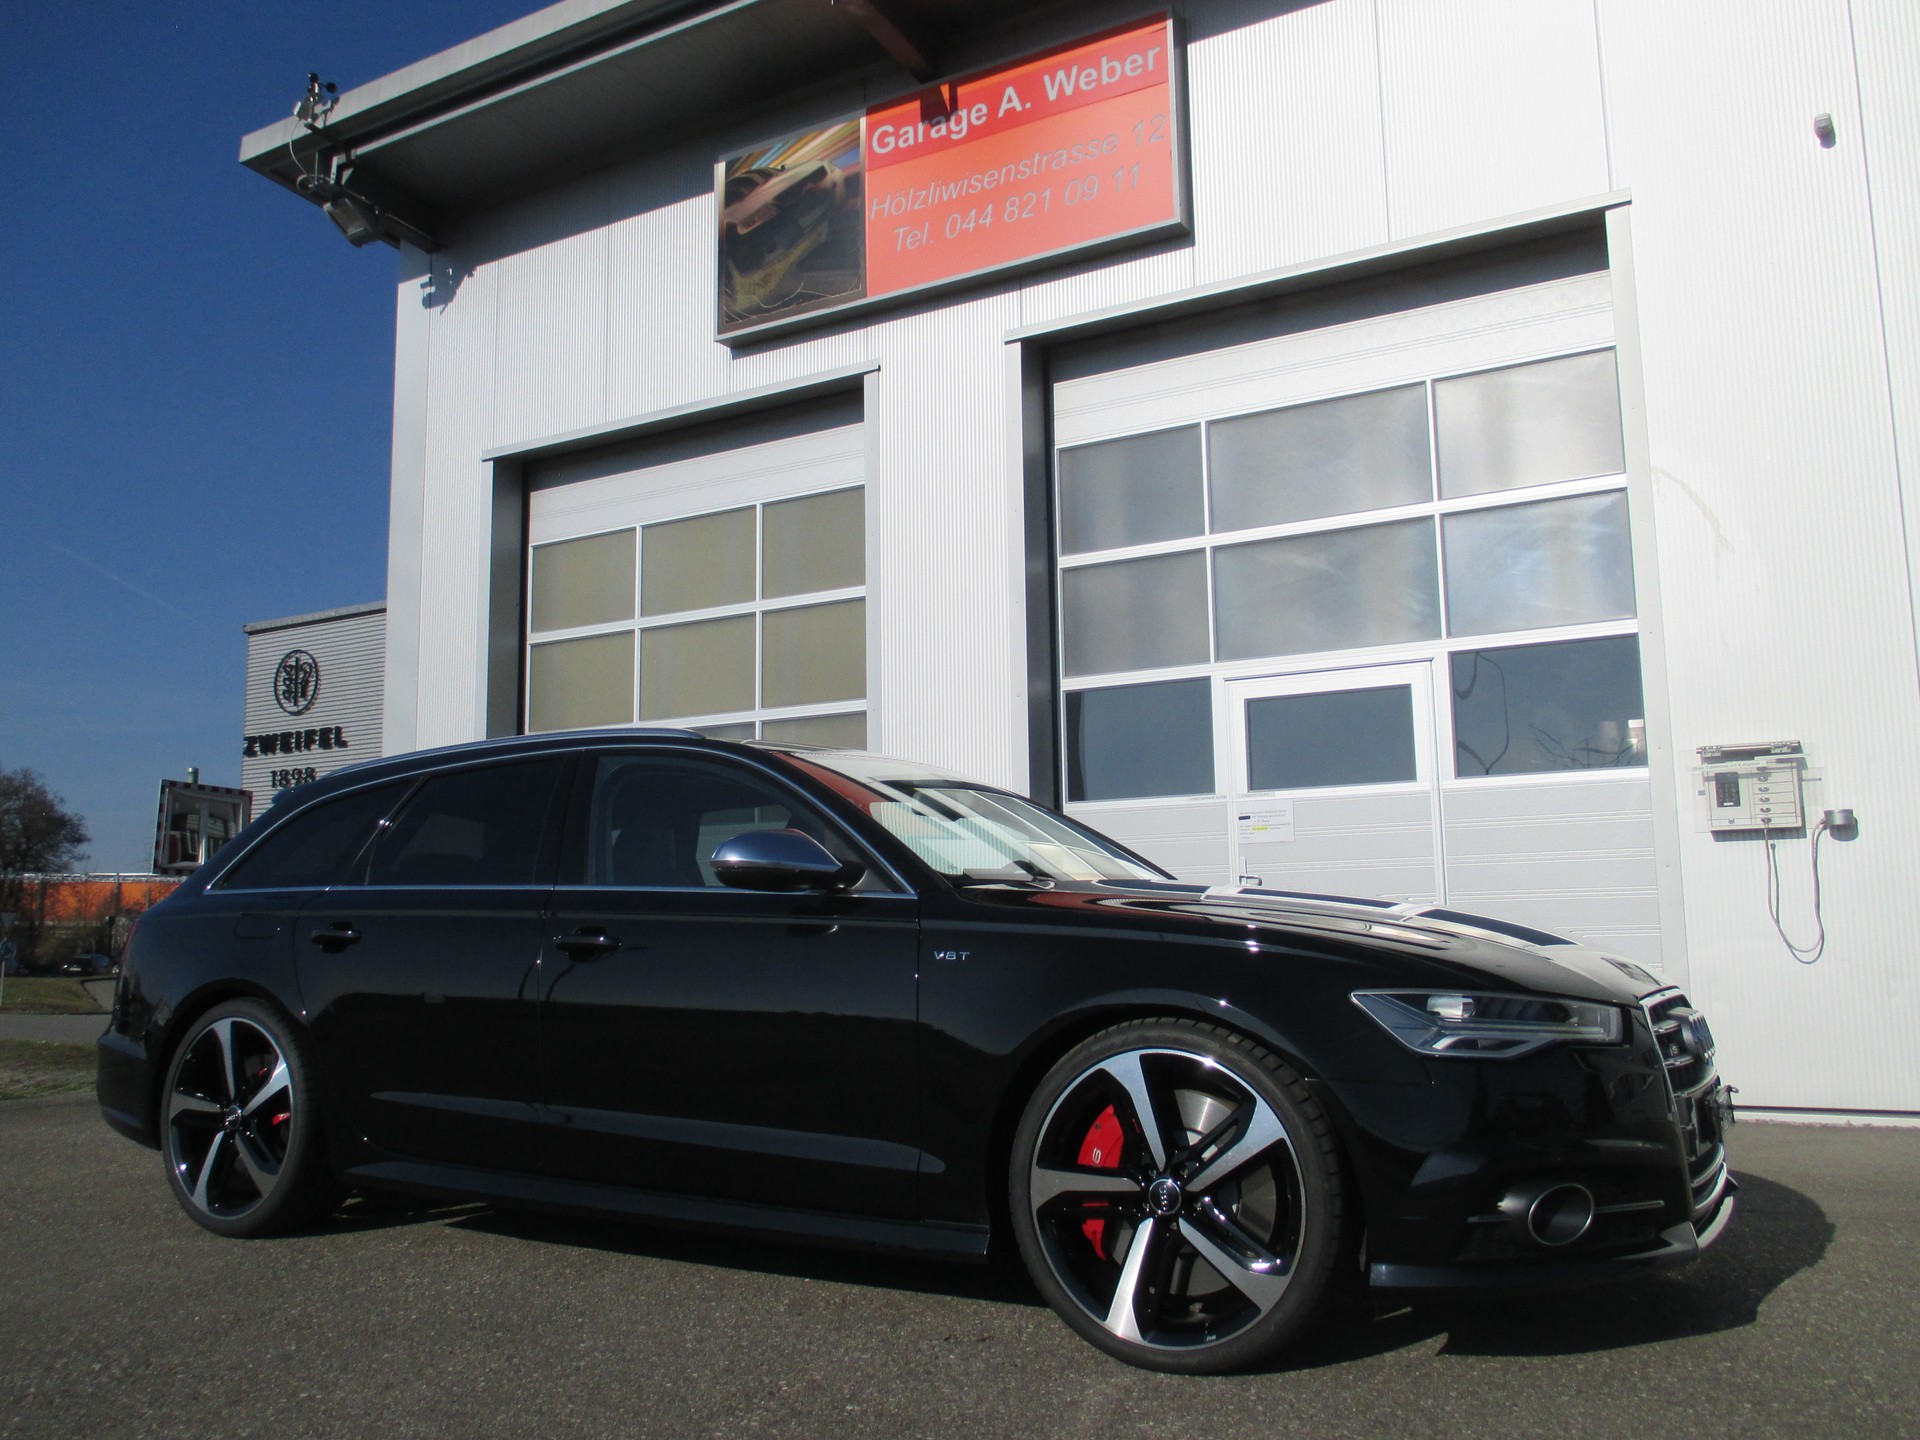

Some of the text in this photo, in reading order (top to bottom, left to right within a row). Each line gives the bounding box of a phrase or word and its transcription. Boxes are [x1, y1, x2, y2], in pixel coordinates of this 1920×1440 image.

[871, 47, 1161, 154] Garage A. Weber
[870, 114, 1167, 220] Hölzliwisenstrasse 12
[893, 162, 1141, 252] Tel. 044 821 09 11
[243, 726, 349, 758] ZWEIFEL
[270, 766, 317, 788] 1898
[933, 950, 970, 961] V8T
